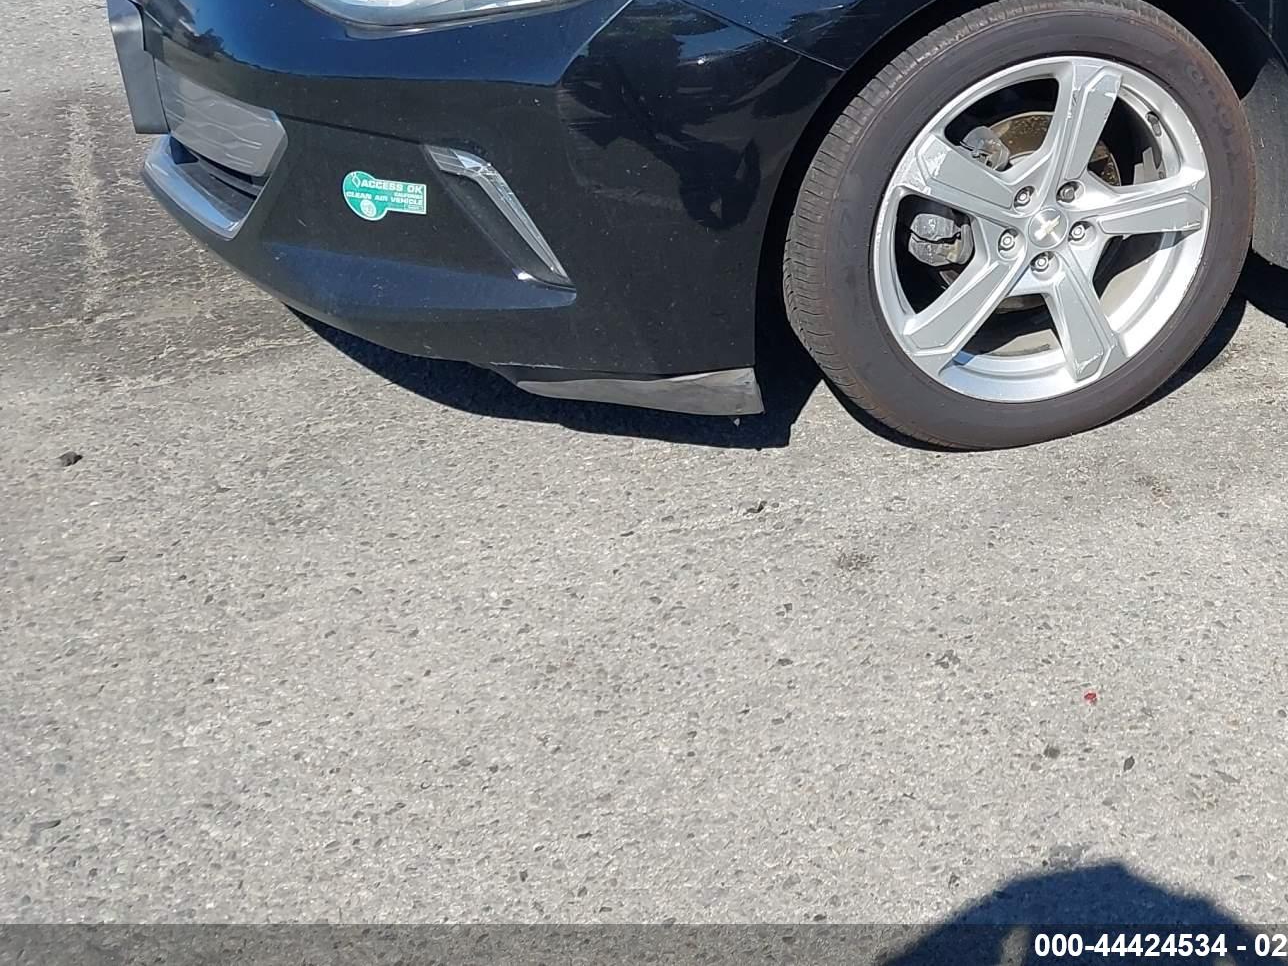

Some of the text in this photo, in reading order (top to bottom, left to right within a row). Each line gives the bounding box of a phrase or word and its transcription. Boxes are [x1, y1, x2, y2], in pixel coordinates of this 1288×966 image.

[361, 179, 423, 194] ACCESS OK
[346, 191, 423, 206] CLEAN AIR VEHICLE
